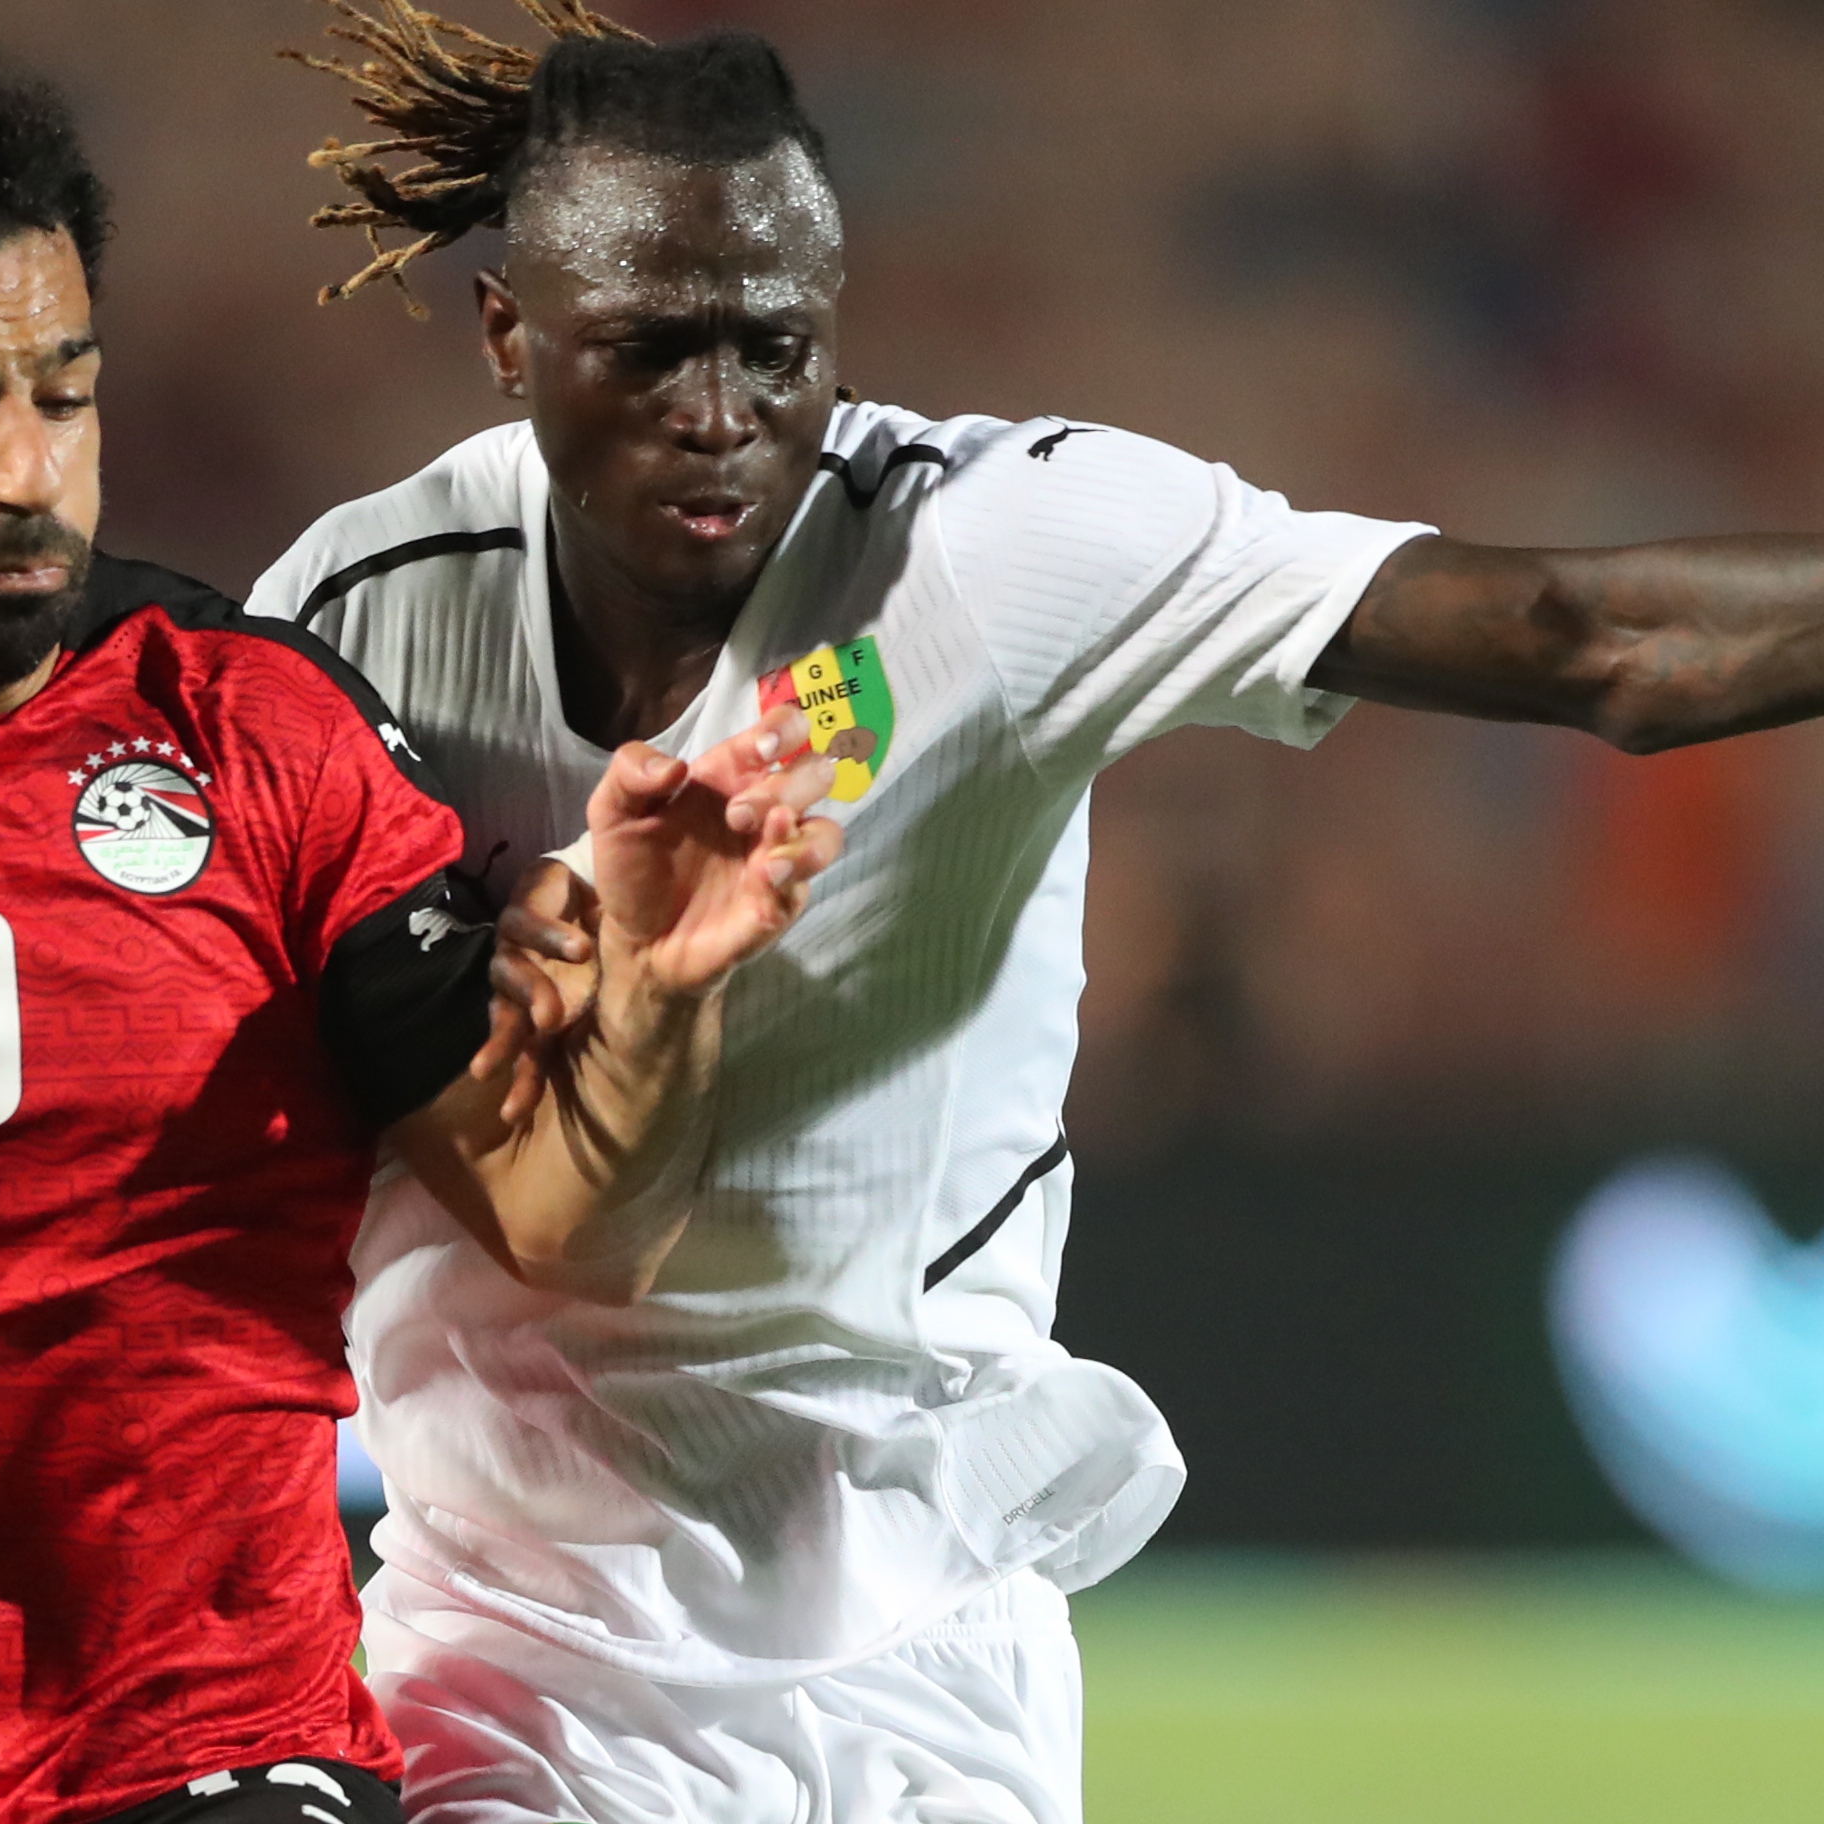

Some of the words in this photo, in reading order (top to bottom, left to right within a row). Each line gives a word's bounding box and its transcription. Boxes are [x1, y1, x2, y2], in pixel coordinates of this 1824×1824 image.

[809, 664, 822, 680] G
[851, 649, 864, 666] F
[784, 677, 862, 710] UINEE
[1002, 1486, 1056, 1526] DRYCELL
